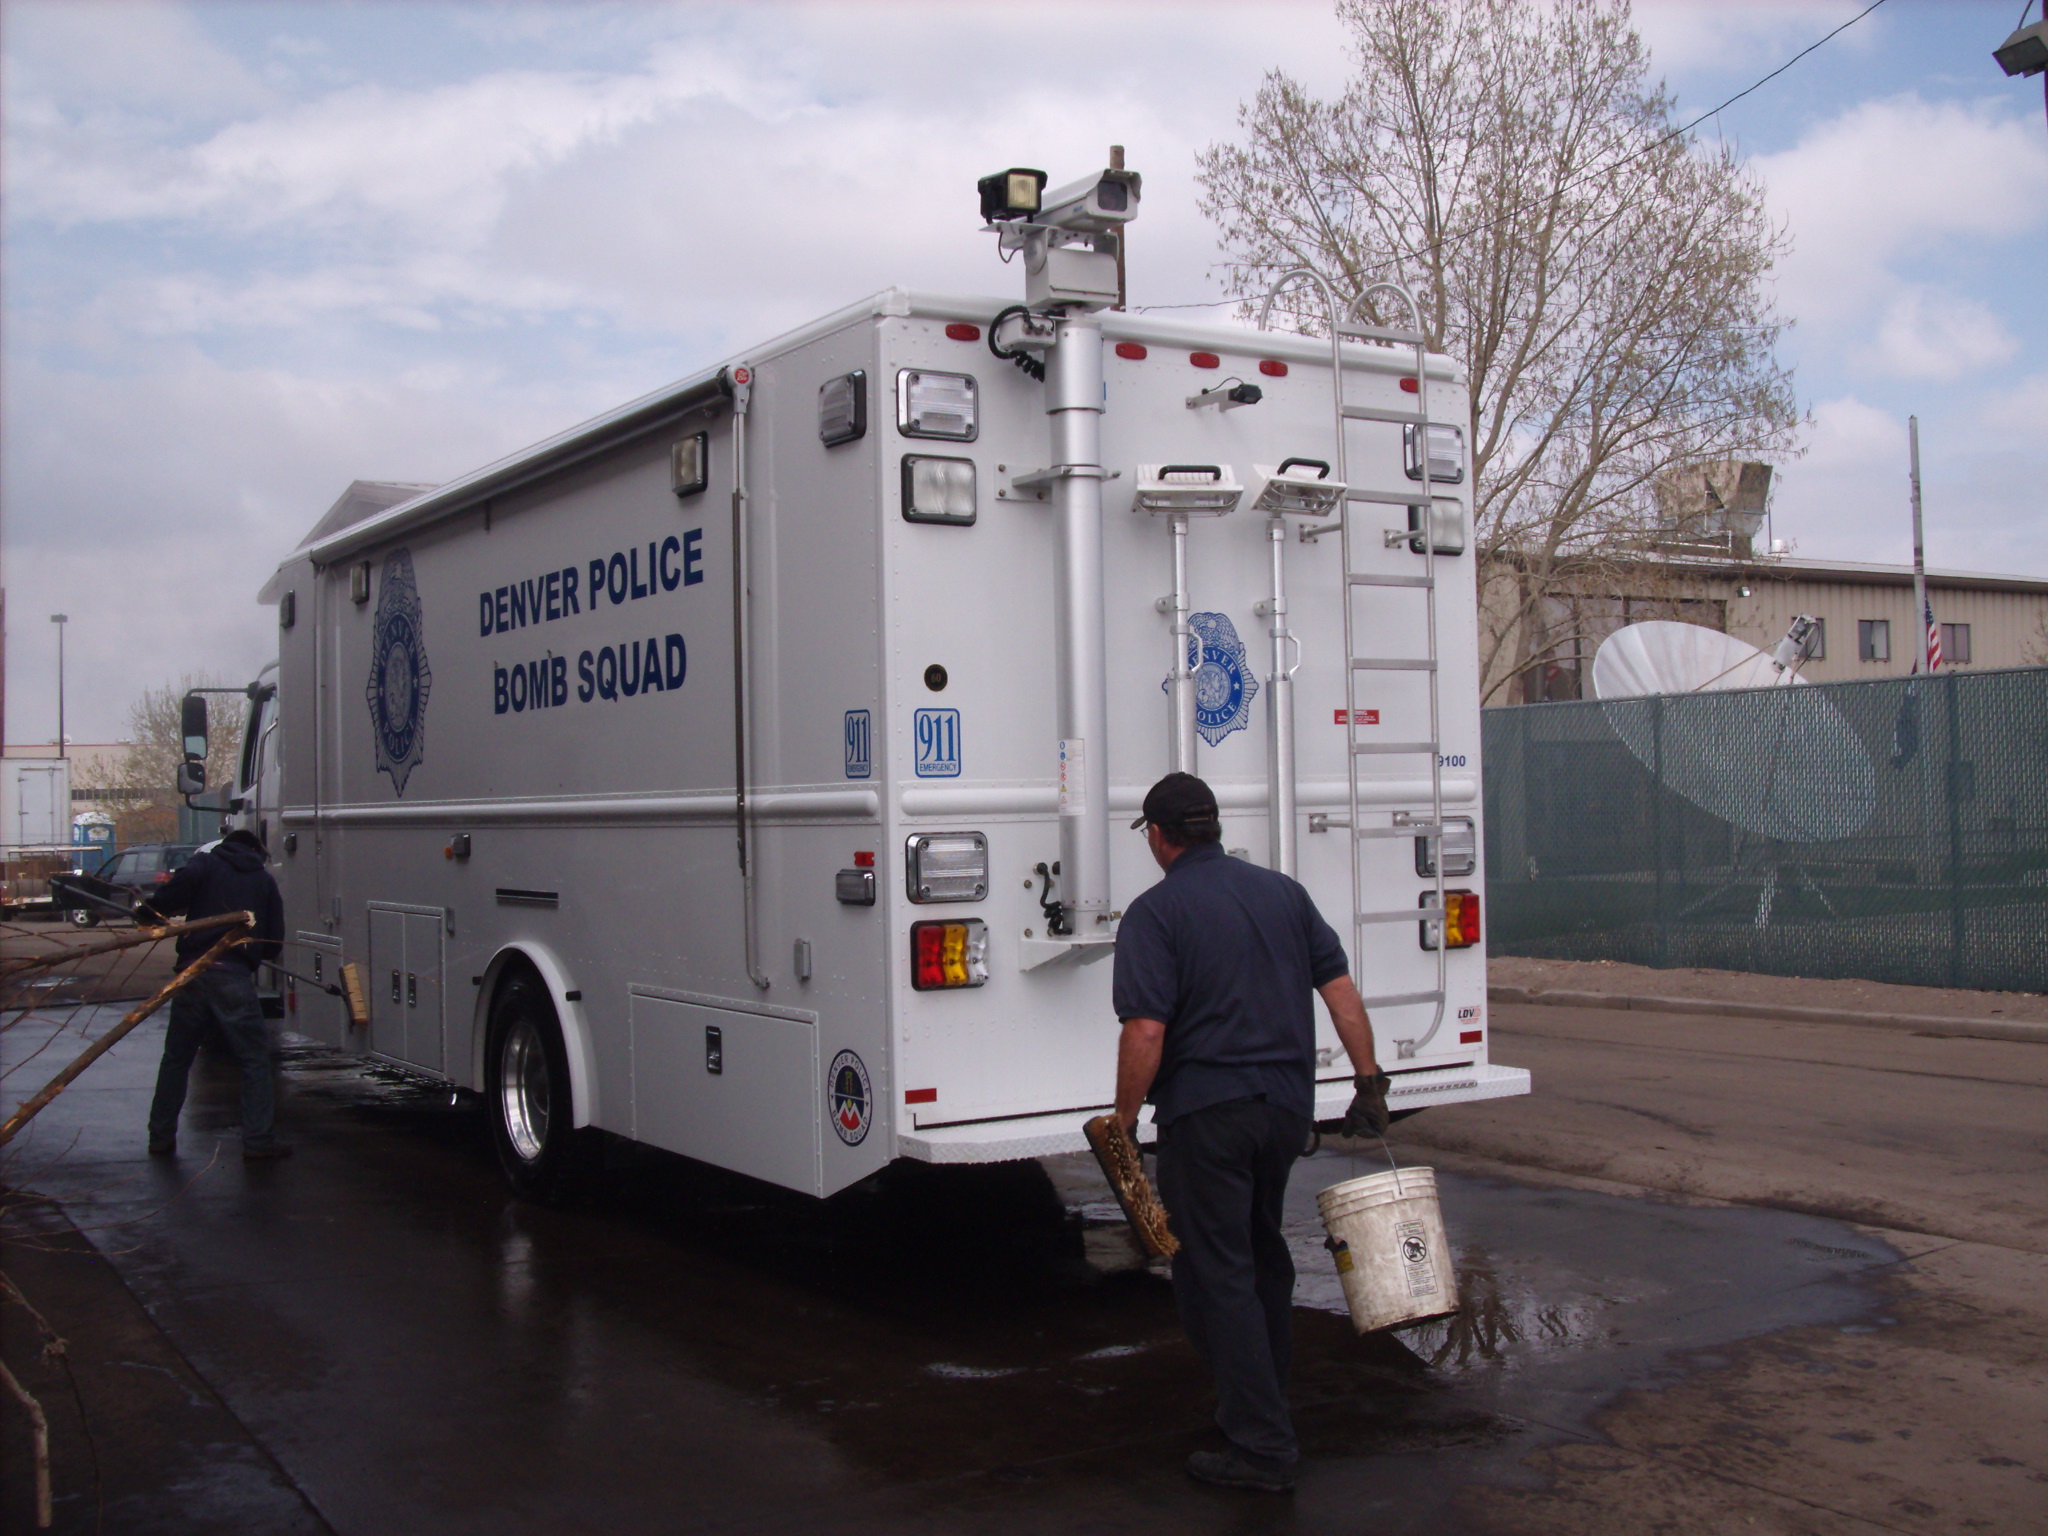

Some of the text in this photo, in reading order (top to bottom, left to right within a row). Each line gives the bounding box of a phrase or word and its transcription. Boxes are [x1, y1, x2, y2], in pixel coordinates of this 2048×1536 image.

[479, 528, 704, 637] DENVER POLICE
[494, 633, 687, 715] BOMB SQUAD
[1197, 702, 1237, 724] OLICE
[847, 716, 869, 762] 911
[919, 713, 957, 762] 911
[920, 763, 957, 772] EMERGENCY
[1438, 755, 1467, 767] 9100
[1458, 1008, 1475, 1019] LDV
[850, 1056, 870, 1094] POLICE
[849, 1116, 868, 1141] SQUAD
